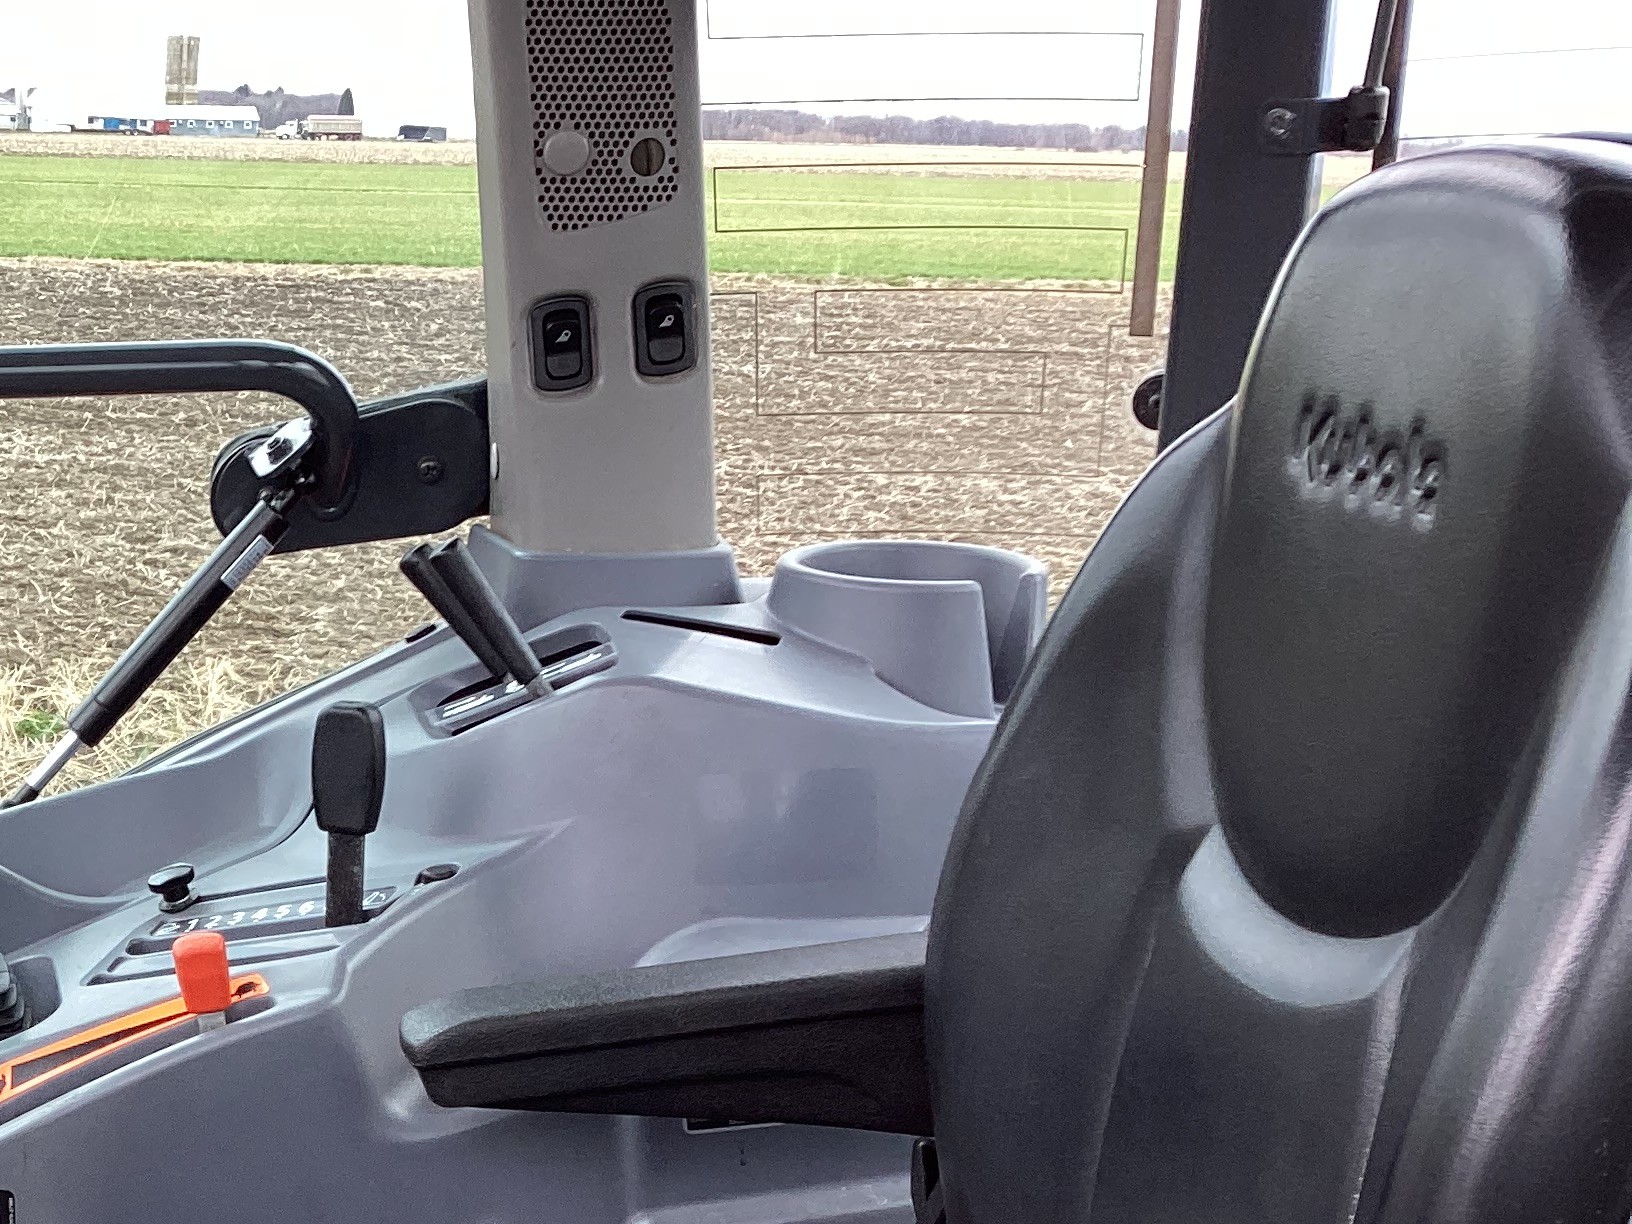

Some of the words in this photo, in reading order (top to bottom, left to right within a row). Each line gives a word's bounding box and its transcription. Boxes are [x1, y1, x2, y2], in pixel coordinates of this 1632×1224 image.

[204, 915, 223, 930] 2
[227, 911, 247, 926] 3
[274, 904, 293, 920] 5
[298, 901, 315, 917] 6
